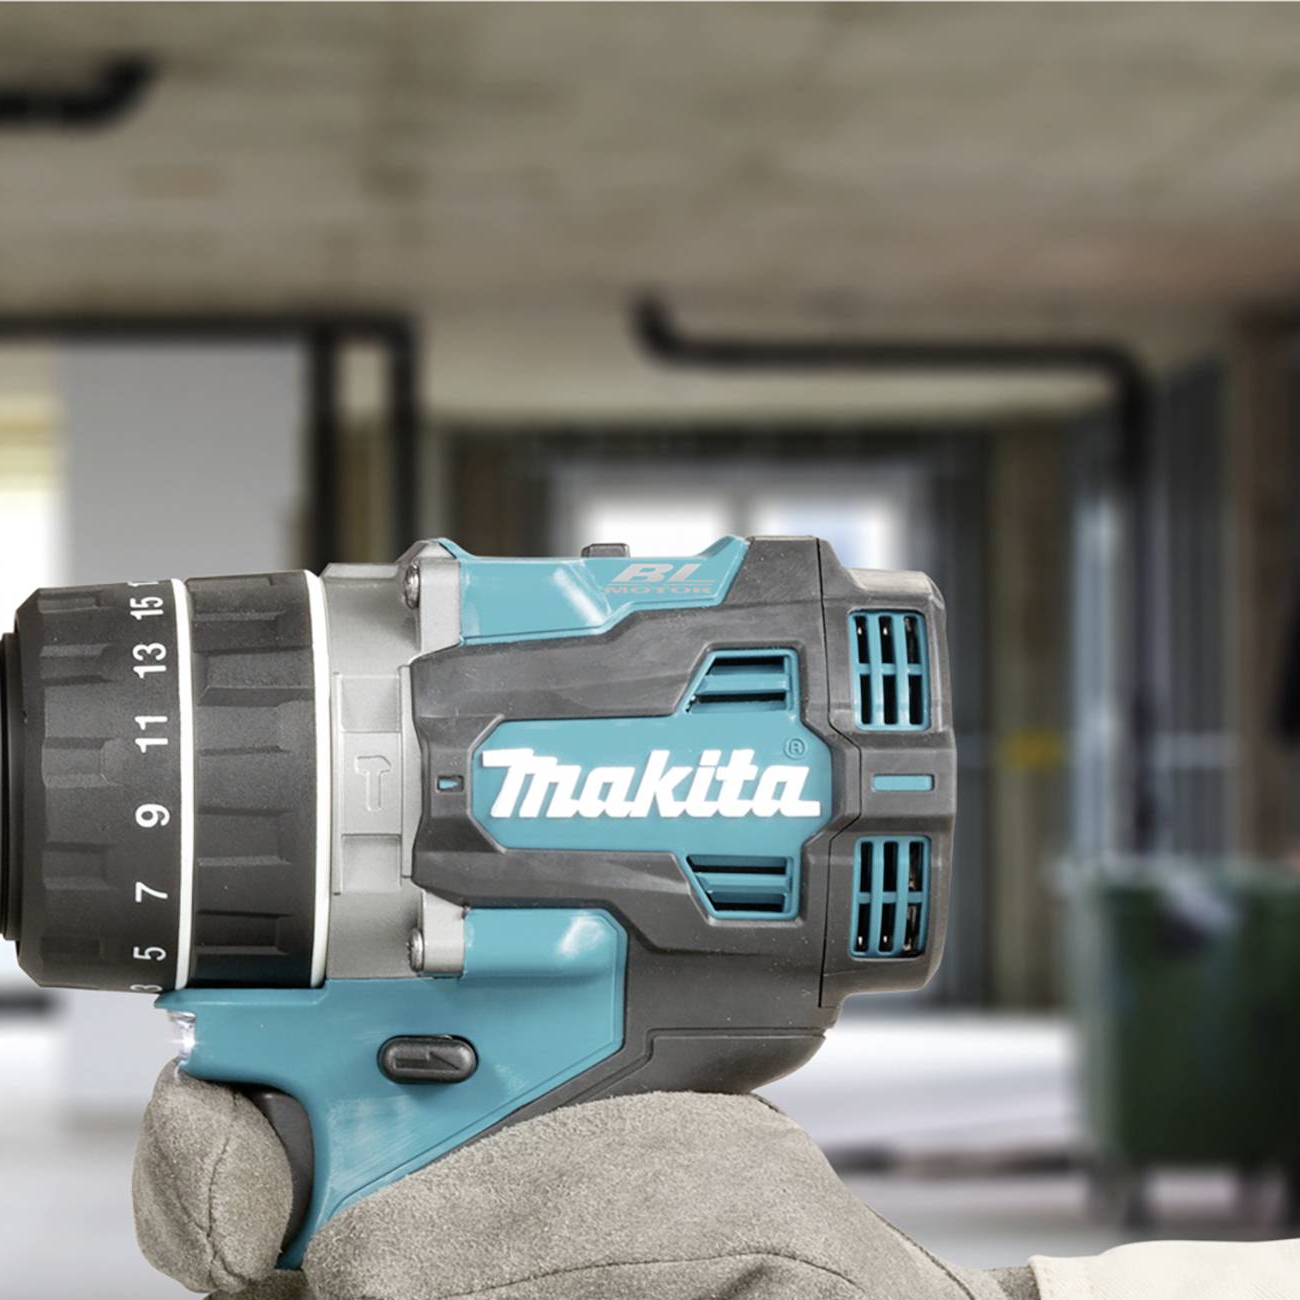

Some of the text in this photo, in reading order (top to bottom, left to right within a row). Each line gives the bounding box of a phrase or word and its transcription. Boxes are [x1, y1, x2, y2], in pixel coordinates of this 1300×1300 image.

[612, 563, 716, 583] BL
[129, 596, 164, 620] 15
[132, 642, 167, 679] 13
[134, 715, 169, 753] 11
[135, 803, 170, 828] 9
[135, 881, 168, 903] 7
[133, 946, 166, 961] 5
